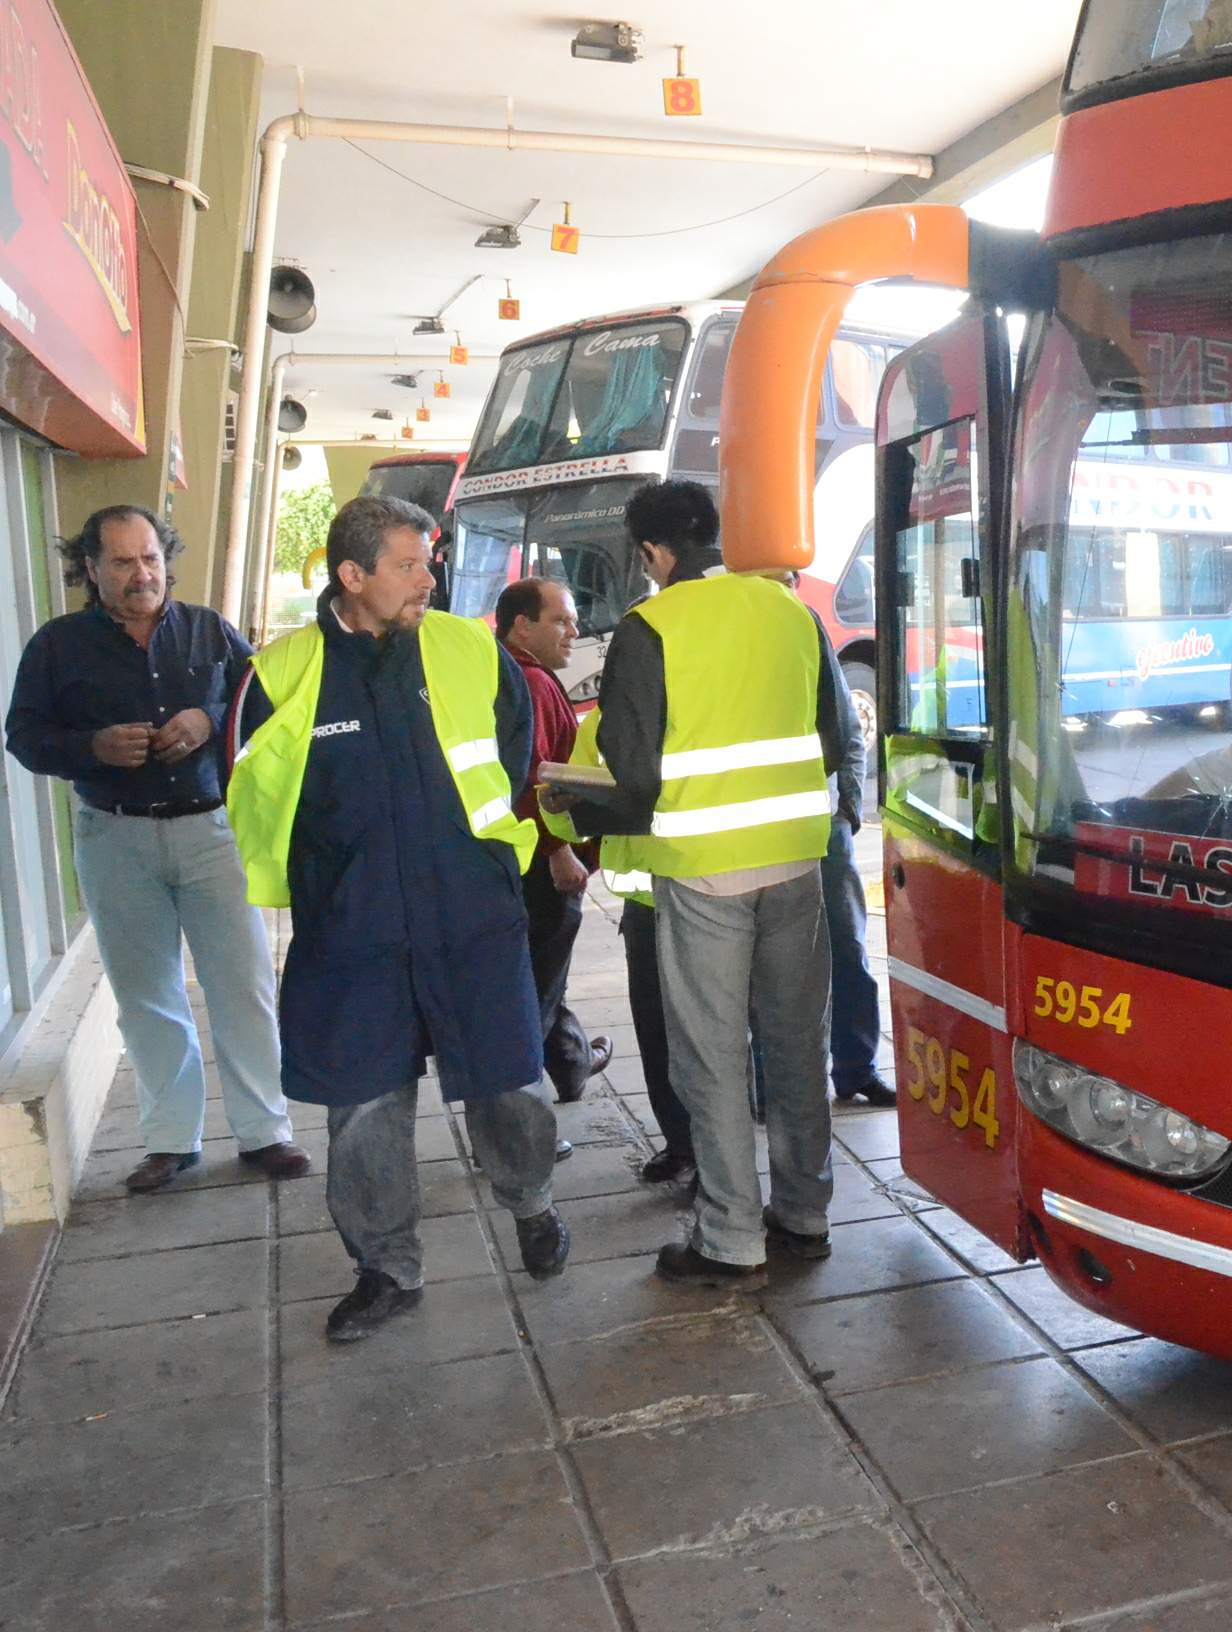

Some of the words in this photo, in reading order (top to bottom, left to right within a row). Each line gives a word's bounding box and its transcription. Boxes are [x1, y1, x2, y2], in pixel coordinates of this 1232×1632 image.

[670, 80, 696, 113] 8
[558, 226, 577, 252] 7
[502, 301, 518, 318] 6
[453, 349, 467, 364] 5
[504, 347, 563, 377] Coche
[584, 331, 661, 356] Cama
[436, 384, 448, 397] 4
[463, 471, 529, 496] CONDOR
[534, 457, 629, 482] ESTRELLA
[1034, 975, 1132, 1034] 5954
[907, 1025, 1000, 1150] 5954
